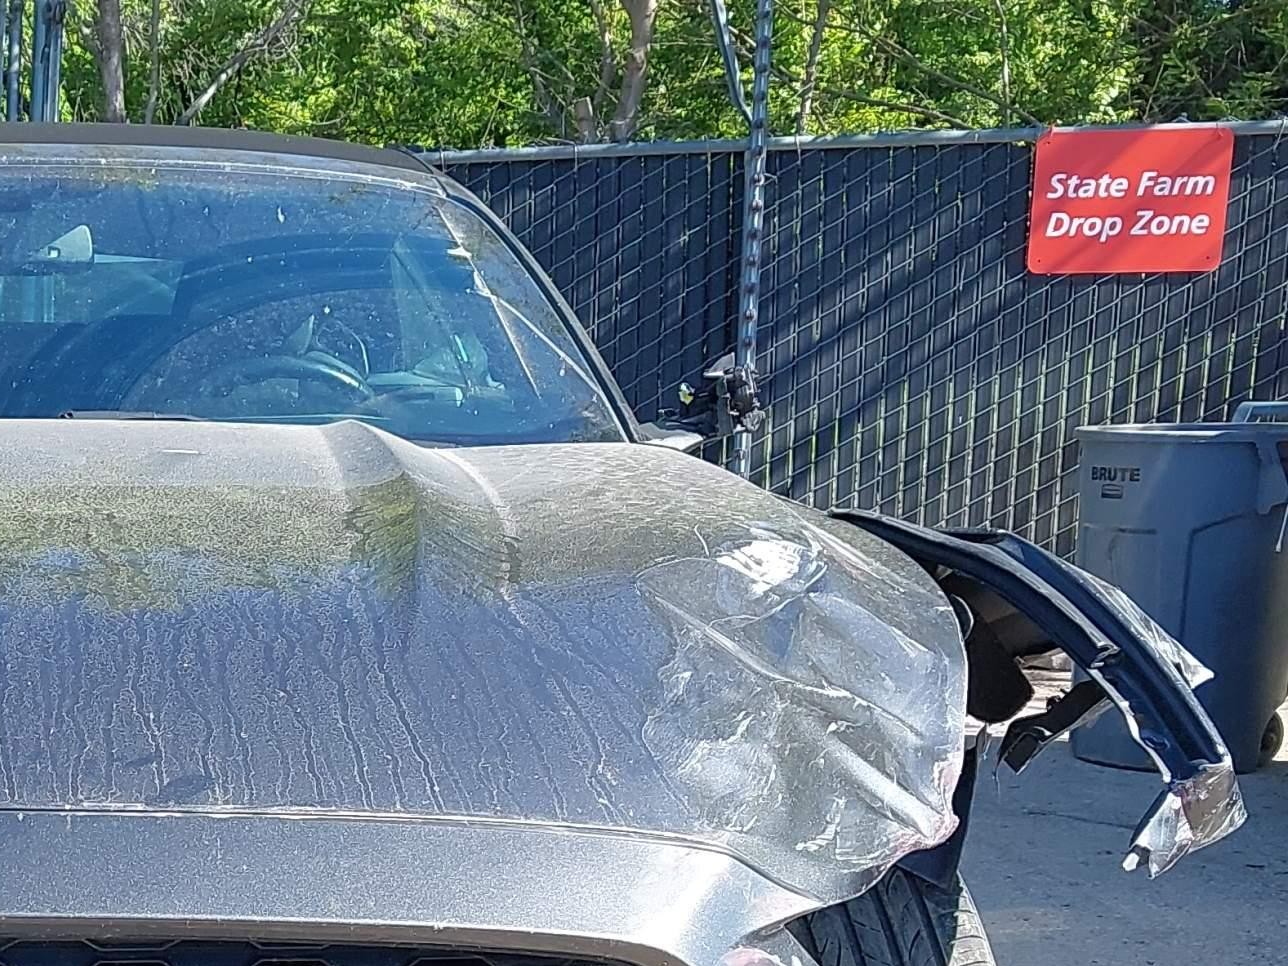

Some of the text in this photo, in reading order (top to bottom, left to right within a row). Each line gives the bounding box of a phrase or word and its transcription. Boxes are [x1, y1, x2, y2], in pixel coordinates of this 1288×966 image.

[1046, 171, 1216, 200] State Farm
[1045, 210, 1210, 243] Drop Zone
[1091, 466, 1141, 482] BRUTE
